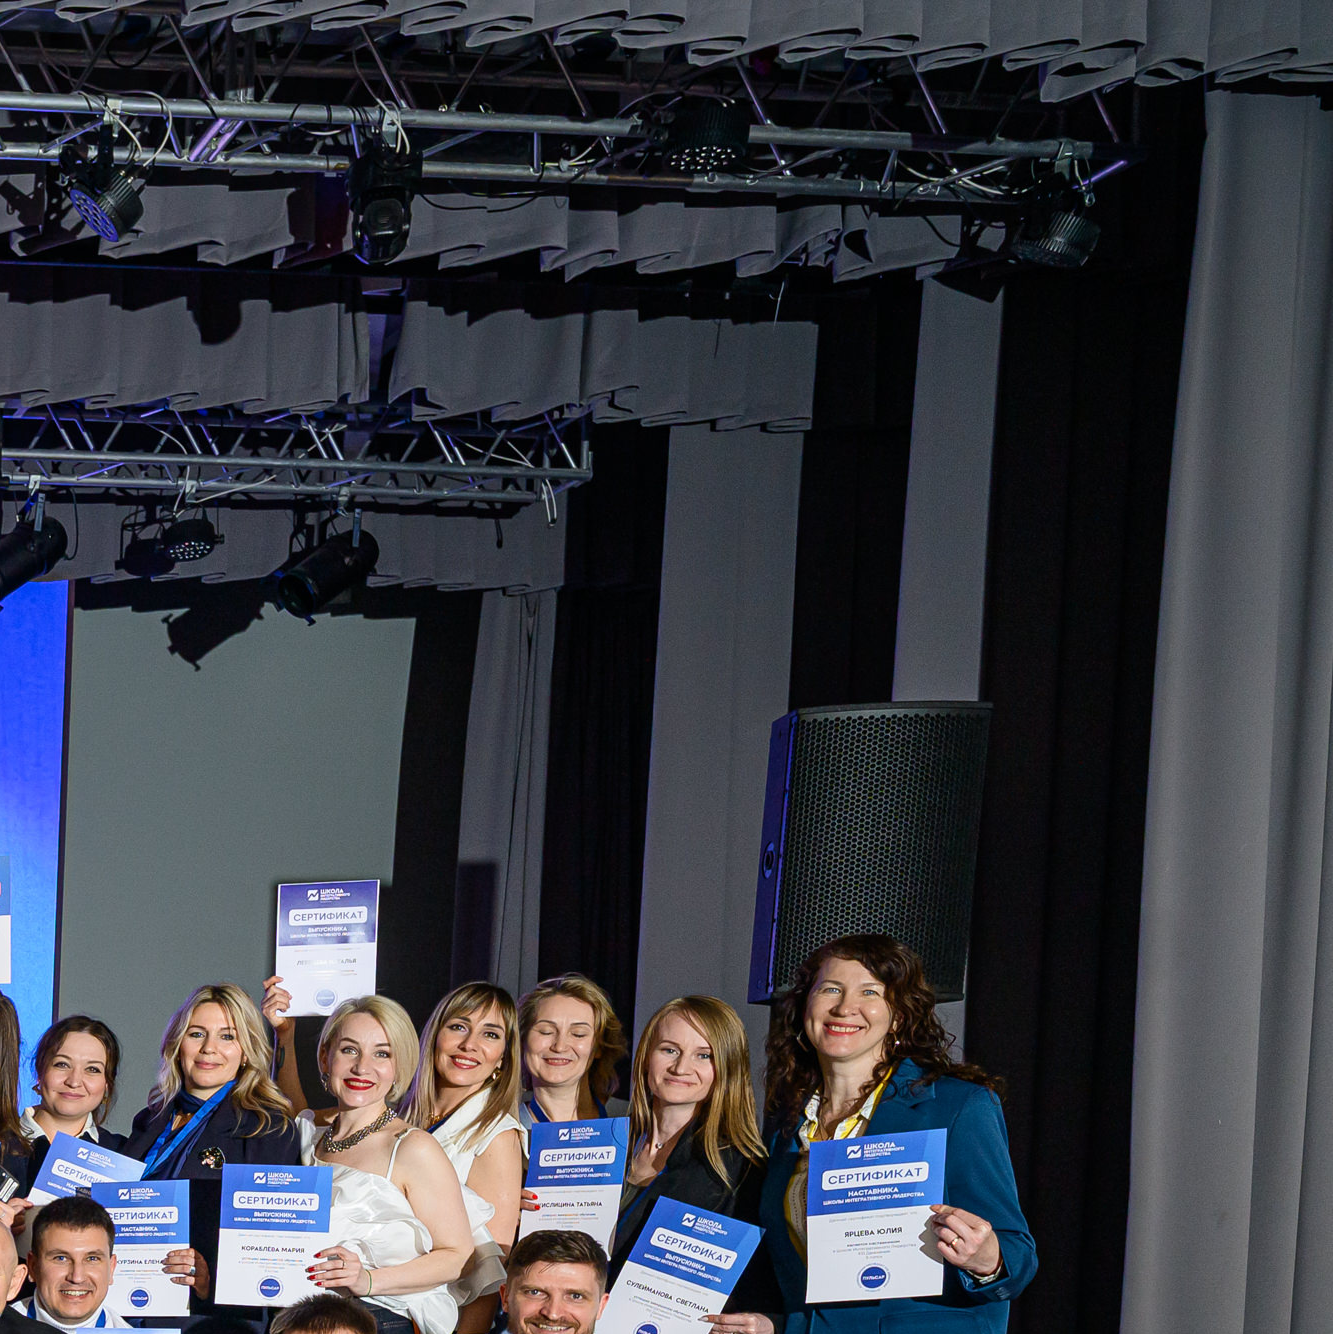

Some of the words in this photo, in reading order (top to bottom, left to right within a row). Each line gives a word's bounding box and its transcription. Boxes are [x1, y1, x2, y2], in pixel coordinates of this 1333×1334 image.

[293, 910, 364, 922] СЕРТИФИКАТ
[863, 1142, 896, 1150] ШКОЛА
[543, 1151, 611, 1162] СЕРТИФИКАТ
[828, 1167, 923, 1184] СЕРТИФИКАТ
[848, 1187, 899, 1197] НАСТАВНИКА
[238, 1196, 314, 1206] СЕРТИФИКАТ
[844, 1229, 875, 1238] ЯРЦЕВА
[877, 1227, 903, 1235] ЮЛИЯ
[657, 1233, 731, 1264] СЕРТИФИКАТ
[664, 1252, 706, 1271] ВЫПУСКНИКА
[626, 1279, 673, 1300] СУЛЕЙМАНОВА
[676, 1297, 709, 1314] СВЕТЛАНА
